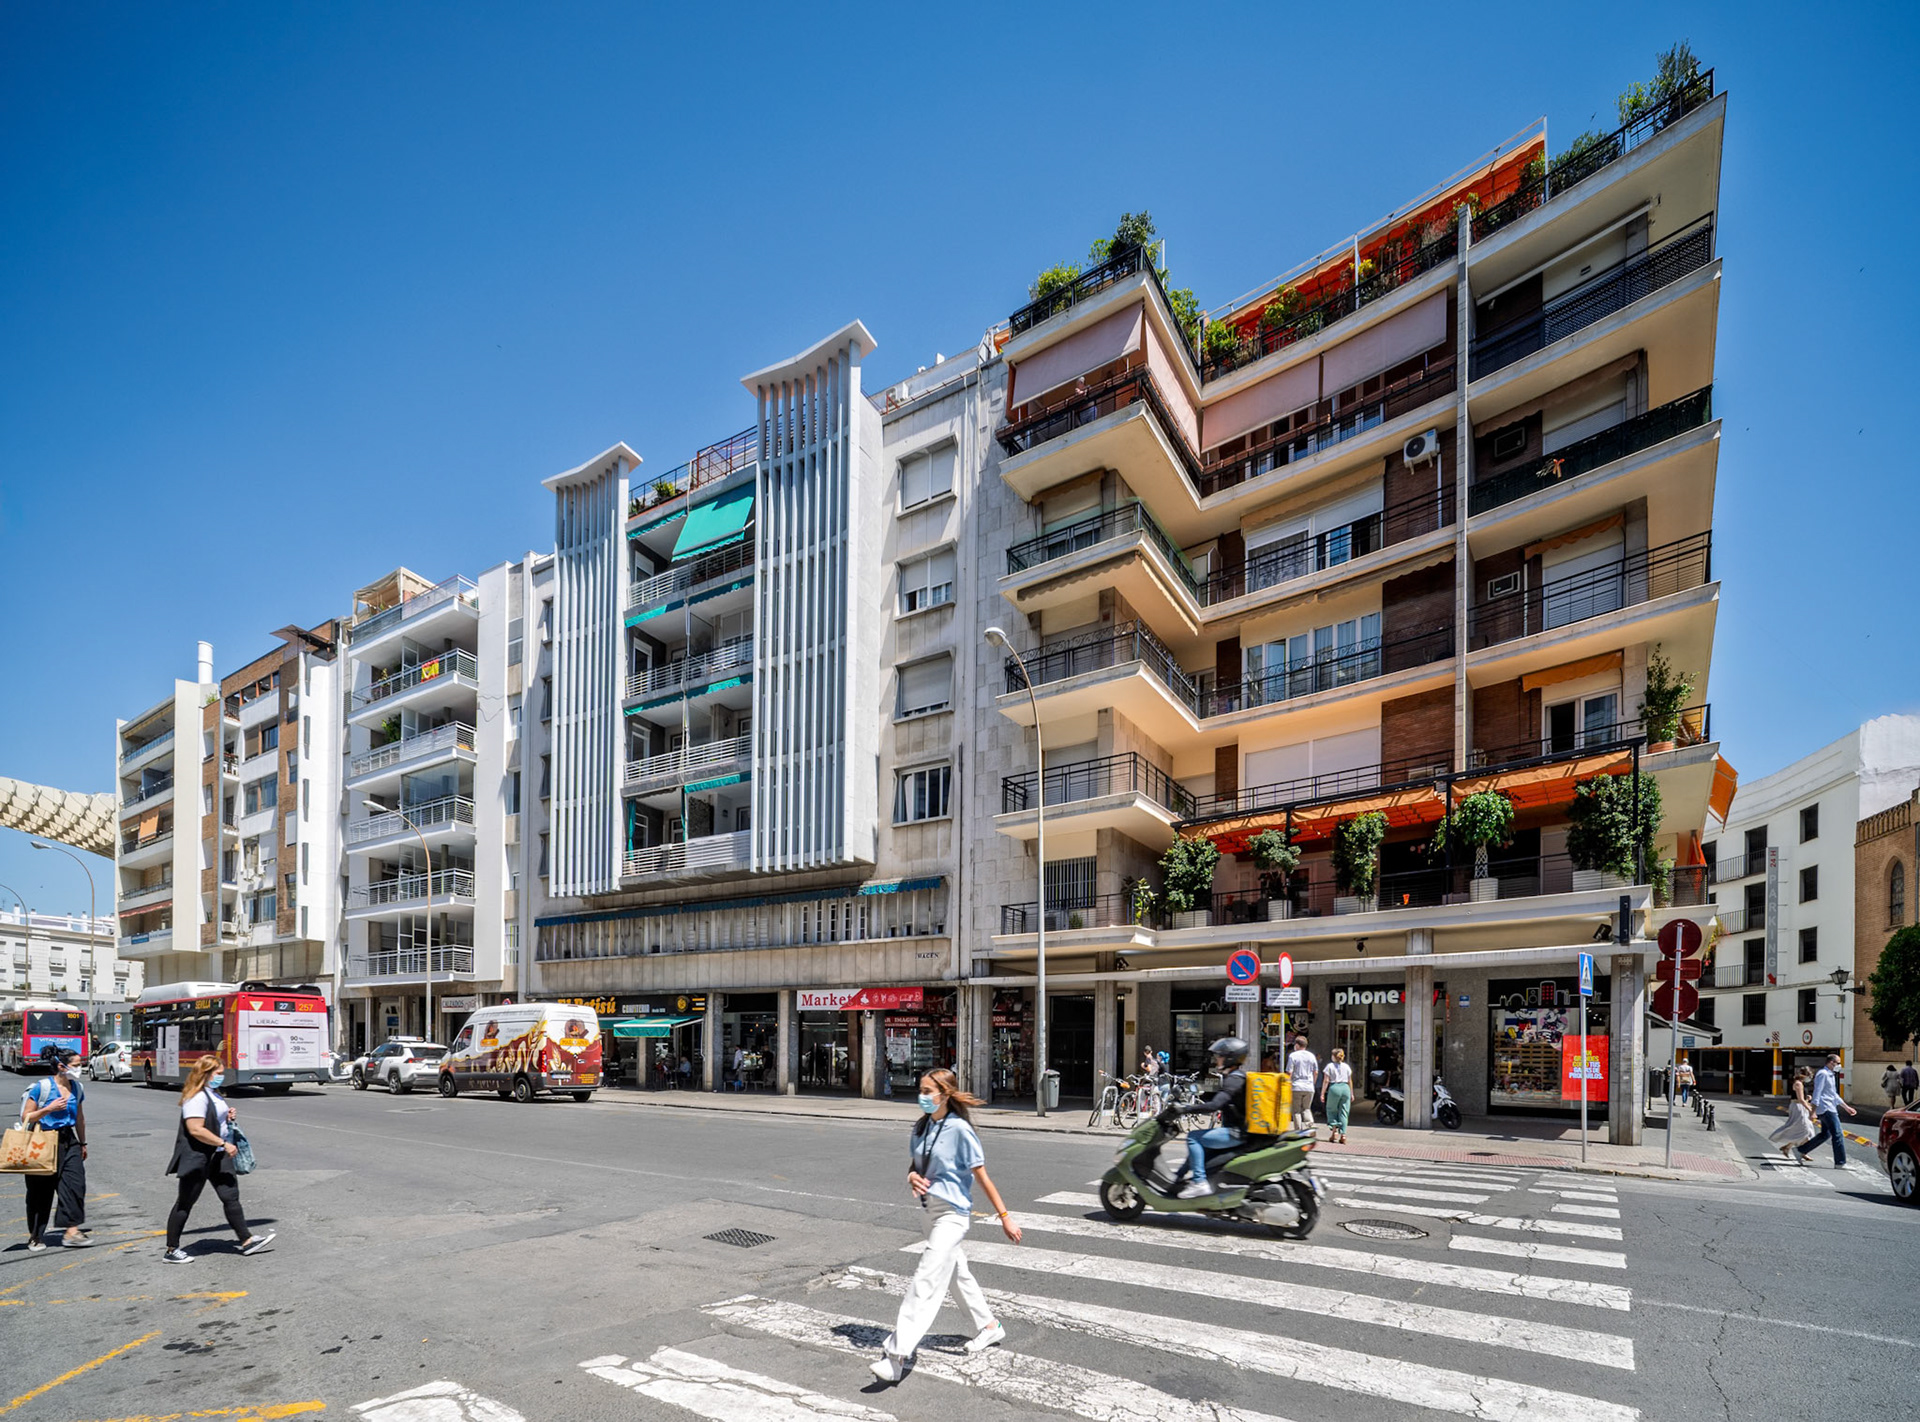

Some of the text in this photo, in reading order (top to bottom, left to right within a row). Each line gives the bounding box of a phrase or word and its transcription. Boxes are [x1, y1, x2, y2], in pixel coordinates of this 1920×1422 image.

[1770, 858, 1776, 867] 24
[1767, 875, 1777, 967] PARKING
[801, 993, 853, 1007] Market
[1335, 987, 1400, 1010] phone
[279, 1002, 289, 1010] 27
[298, 1003, 314, 1012] 257
